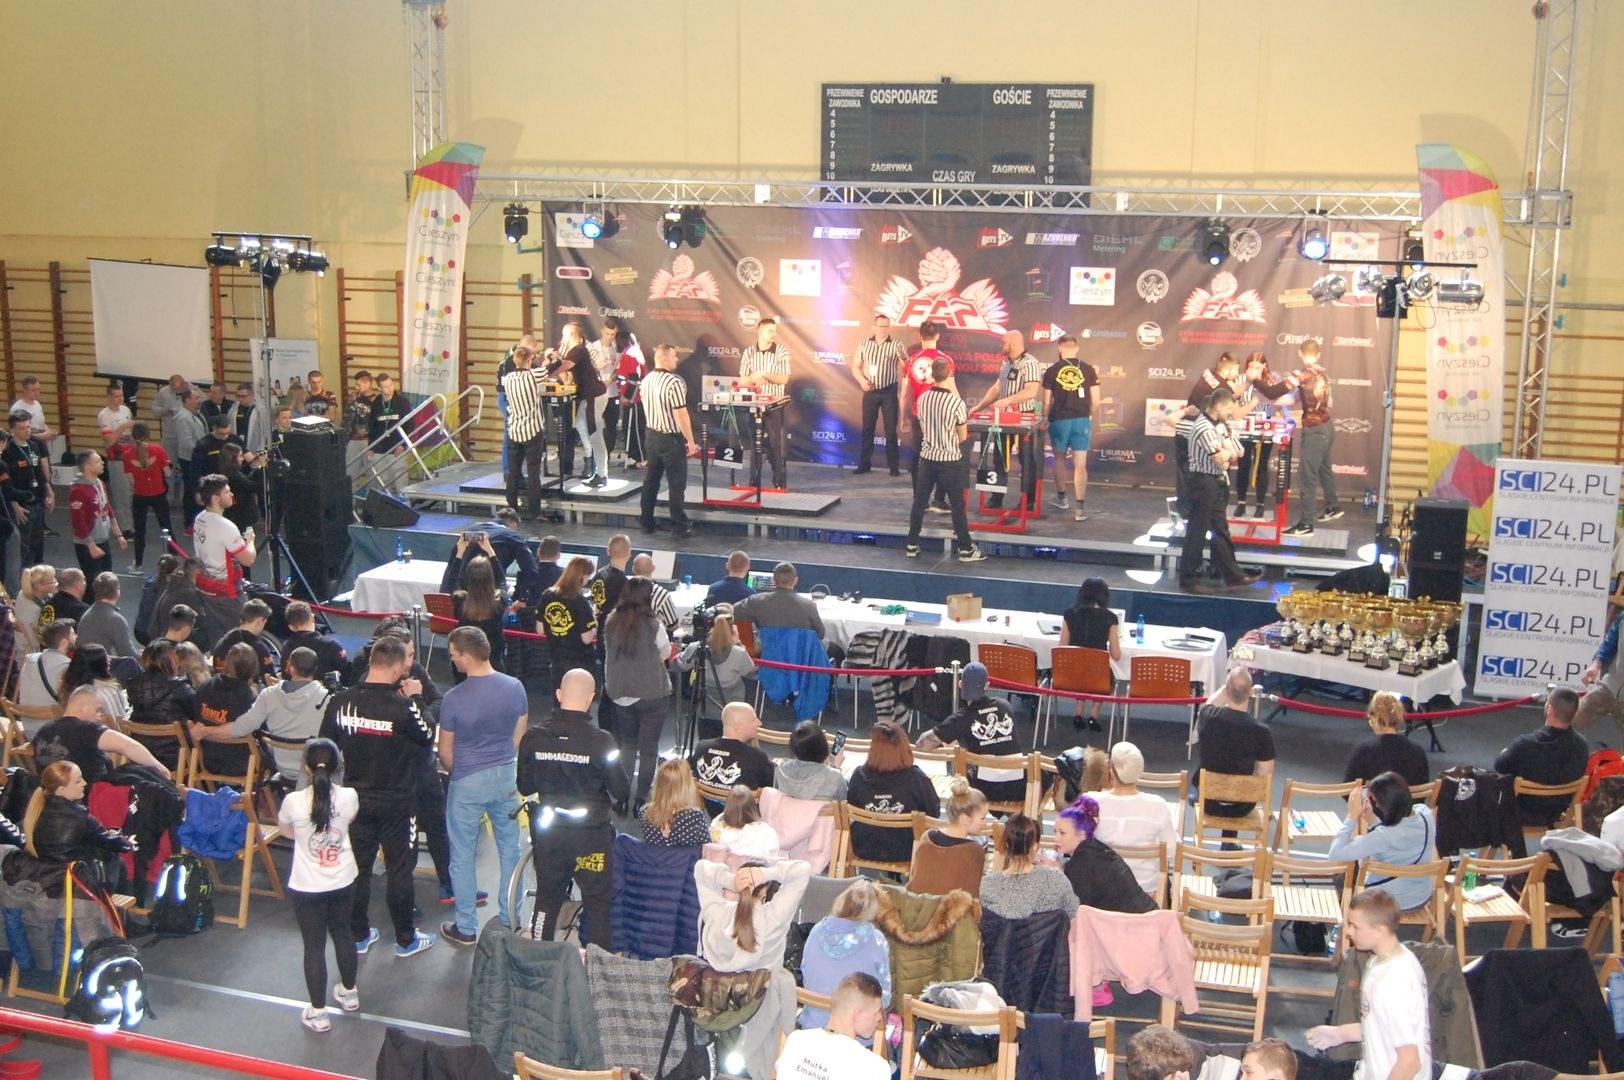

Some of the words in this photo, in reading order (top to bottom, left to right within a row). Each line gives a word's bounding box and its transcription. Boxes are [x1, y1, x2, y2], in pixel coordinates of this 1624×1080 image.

[870, 88, 938, 104] GOSPODARZE
[992, 85, 1032, 105] GOŚCIE
[828, 98, 862, 108] ZAWODNIKA
[1048, 99, 1084, 109] ZAWODNIKA
[830, 108, 836, 118] 4
[1049, 110, 1056, 119] 4
[830, 119, 836, 128] 5
[1049, 121, 1055, 130] 5
[830, 130, 836, 139] 6
[1048, 132, 1055, 141] 6
[830, 140, 835, 149] 7
[1049, 143, 1055, 152] 7
[830, 150, 835, 159] 8
[1048, 153, 1055, 163] 8
[829, 161, 835, 170] 9
[870, 163, 913, 172] ZAGRYWKA
[991, 164, 1036, 174] ZAGRYWKA
[1048, 164, 1054, 174] 9
[826, 171, 835, 180] 10
[932, 169, 956, 182] CZAS
[957, 170, 976, 182] GRY
[1043, 175, 1054, 184] 10
[418, 224, 460, 243] Cieszyn
[1093, 234, 1143, 244] DIEHL
[415, 270, 455, 289] Cieszyn
[413, 317, 451, 334] Ceszyn
[707, 346, 741, 356] SCI24.PL
[413, 362, 450, 378] Ceszyn
[1148, 367, 1186, 377] SCI24.PL
[812, 430, 847, 441] SCI24.PL
[723, 447, 734, 461] 2
[986, 470, 998, 485] 3
[1502, 470, 1616, 496] SCI24.PL
[1530, 493, 1567, 502] CENTRUM
[1498, 517, 1610, 544] SCI24.PL
[1525, 540, 1563, 549] CENTRUM
[1493, 563, 1606, 590] SCI24.PL
[1521, 586, 1558, 594] CENTRUM
[1488, 610, 1600, 638] SCI24.PL
[1516, 633, 1553, 642] CENTRUM
[1484, 656, 1588, 681] SCI24.P
[534, 751, 591, 765] RUNMAGEDDON
[803, 1057, 828, 1072] Mutka
[796, 1064, 830, 1080] Emanuel
